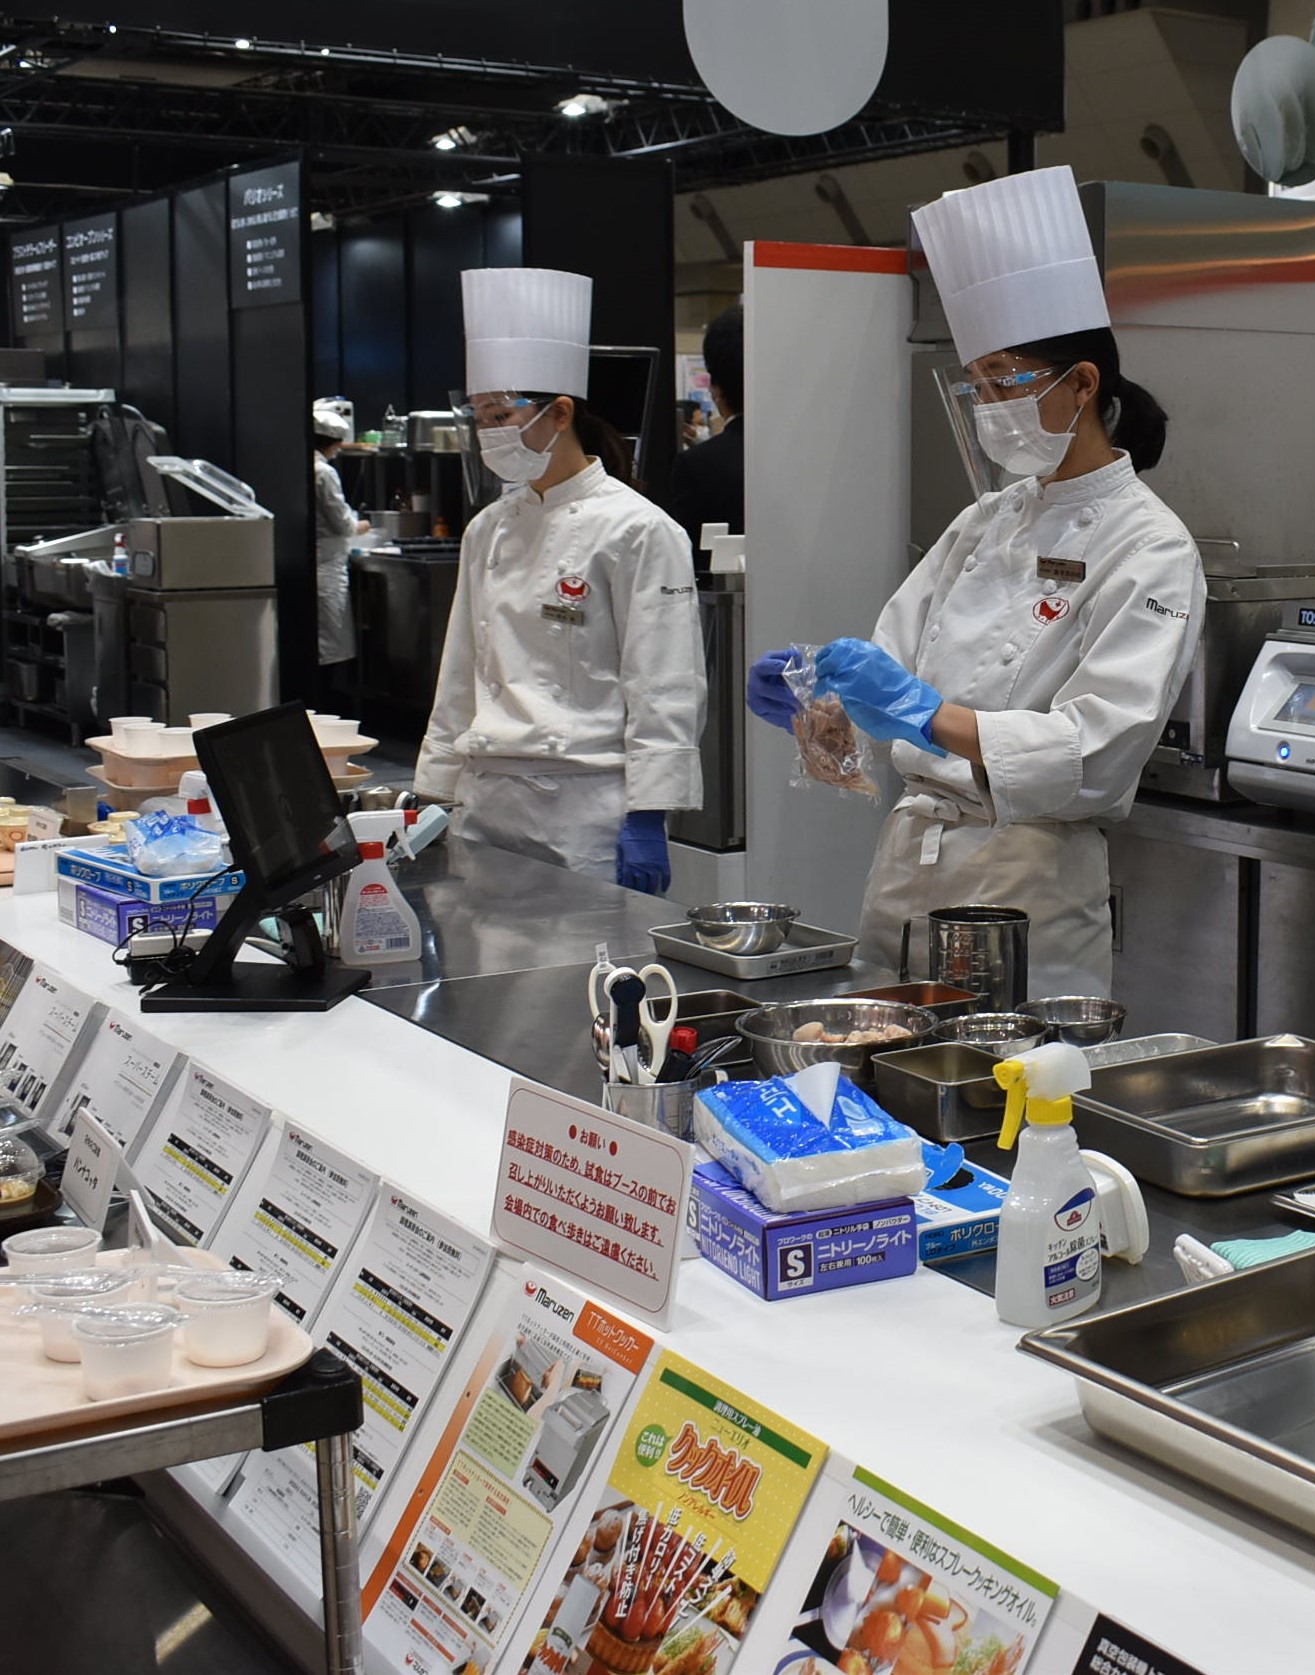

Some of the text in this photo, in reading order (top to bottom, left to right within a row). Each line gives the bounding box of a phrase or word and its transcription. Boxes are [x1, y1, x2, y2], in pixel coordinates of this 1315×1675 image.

[1146, 597, 1189, 621] Maruz
[580, 1129, 606, 1149] お願い
[507, 1129, 677, 1216] 感染症対策のため、試食はブースの前でお
[508, 1162, 664, 1247] 召し上がりいただくようお願い致します。
[689, 1200, 698, 1230] S
[818, 1229, 913, 1260] ニトリーノライト
[787, 1249, 806, 1278] S
[535, 1287, 575, 1324] Maruzen
[640, 1430, 665, 1447] これは
